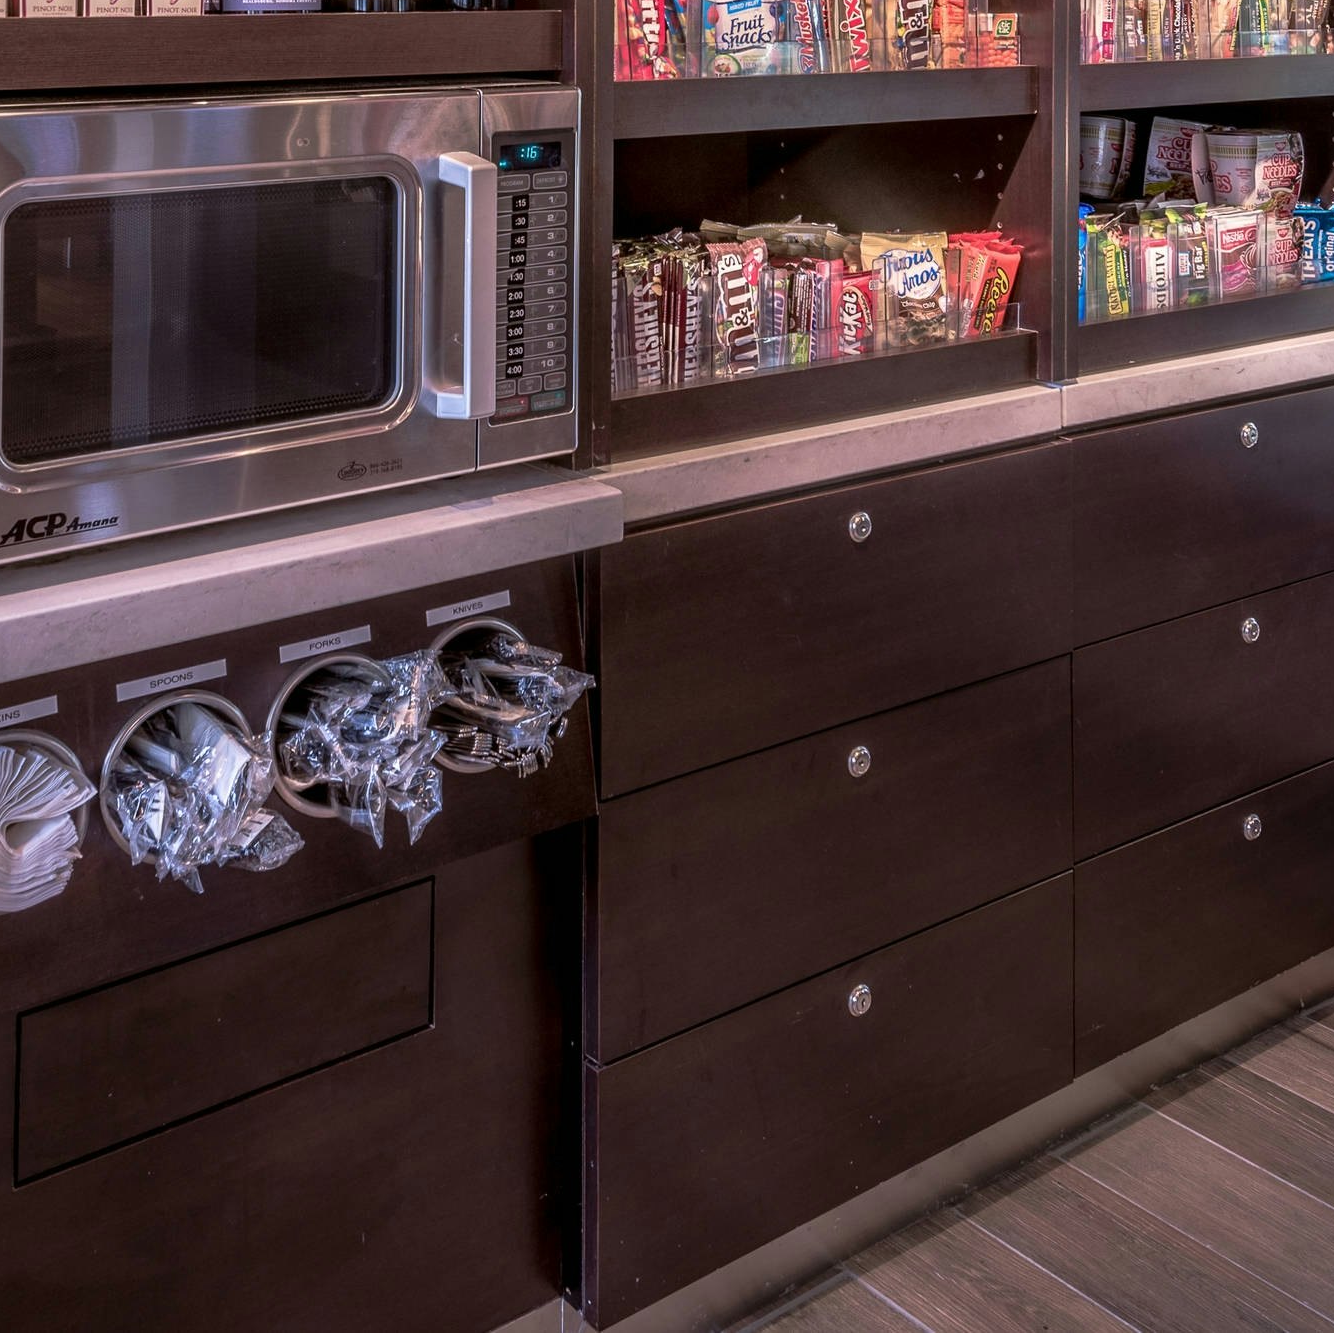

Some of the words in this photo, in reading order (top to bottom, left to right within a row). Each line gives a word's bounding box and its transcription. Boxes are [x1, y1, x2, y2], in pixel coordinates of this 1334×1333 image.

[33, 5, 56, 13] PINOT
[731, 15, 765, 35] Fruit
[721, 29, 772, 49] Snacks
[1273, 153, 1291, 166] CUP
[1263, 164, 1298, 180] NOODLES
[1275, 239, 1292, 252] CUP
[0, 512, 67, 545] ACP
[67, 516, 120, 532] Amana
[451, 600, 484, 617] KNIVES
[308, 635, 342, 653] FORKS
[149, 671, 194, 691] SPOONS
